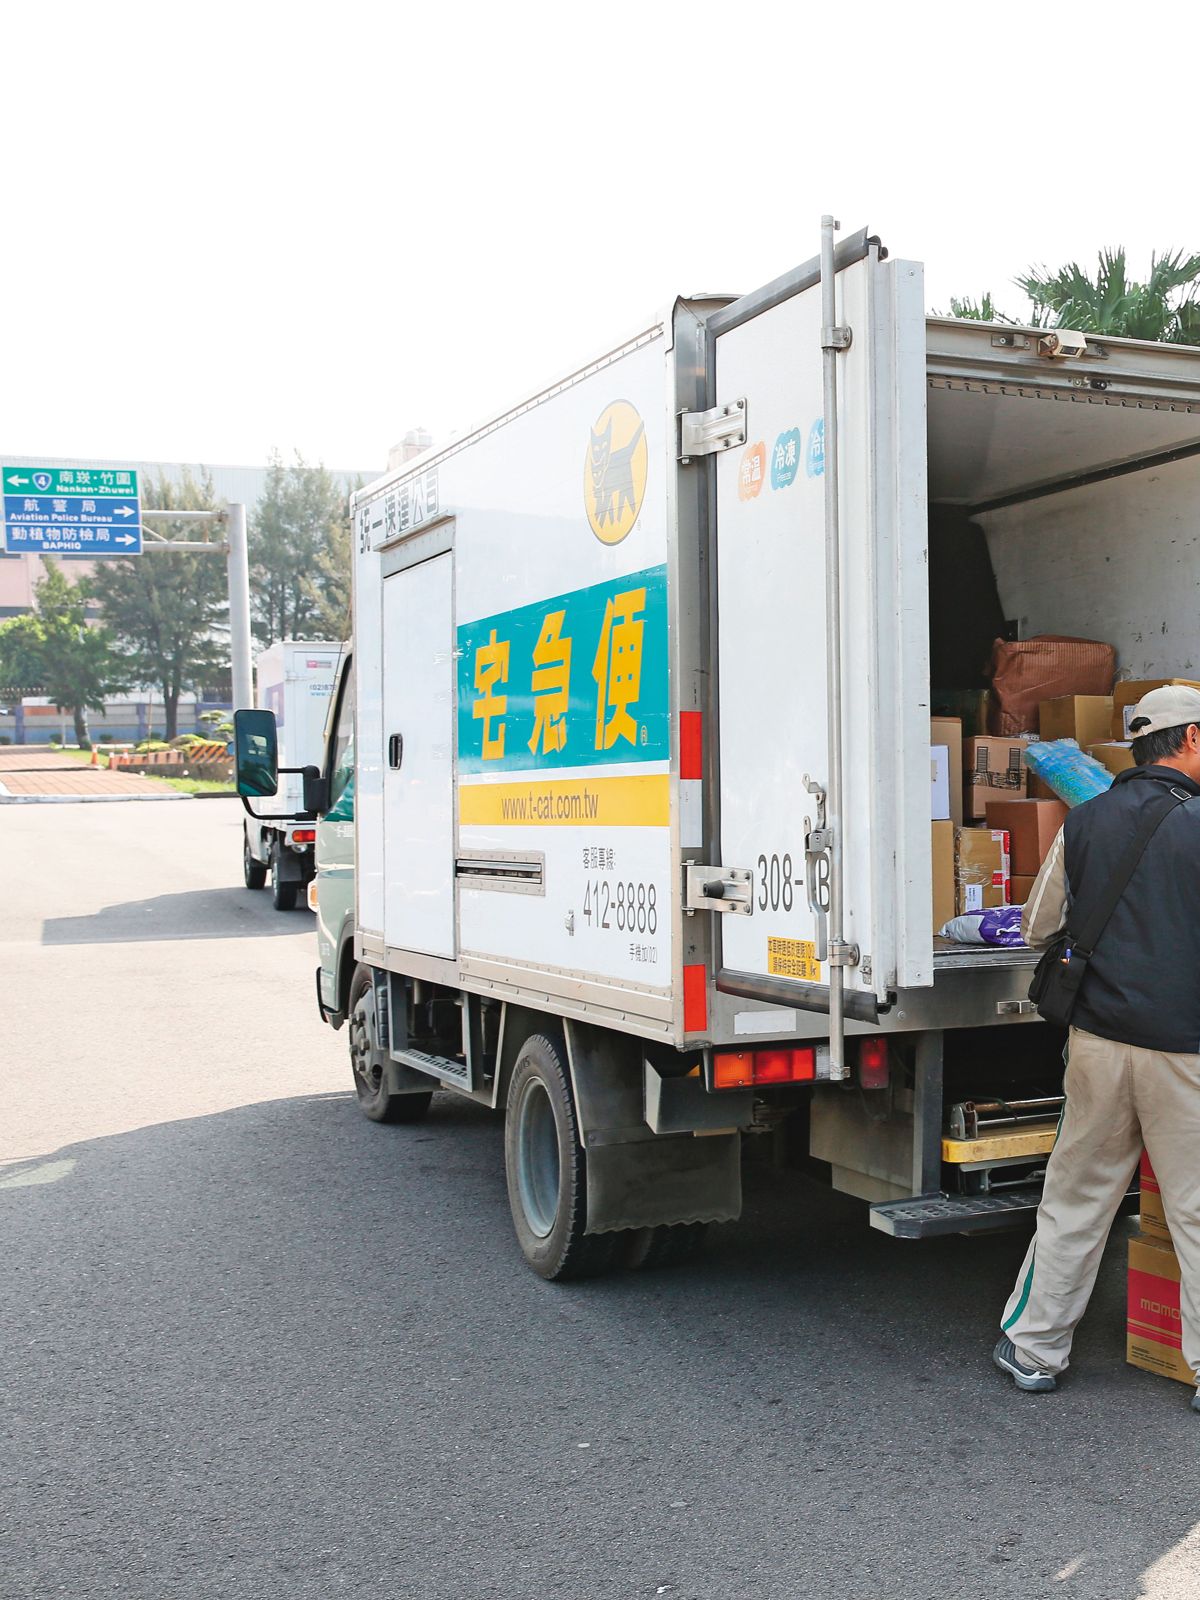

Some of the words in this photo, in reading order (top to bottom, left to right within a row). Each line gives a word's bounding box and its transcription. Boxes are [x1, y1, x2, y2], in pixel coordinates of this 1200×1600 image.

[775, 438, 796, 470] 冷凍
[38, 476, 46, 486] 4
[10, 513, 49, 521] Aviation
[51, 513, 79, 522] Police
[80, 514, 113, 523] Bureau
[472, 587, 647, 761] 宅急便
[501, 788, 599, 820] www.t-cat.com.tw
[758, 851, 830, 914] 308-B
[583, 879, 657, 935] 412-8888
[1140, 1298, 1181, 1320] momo
